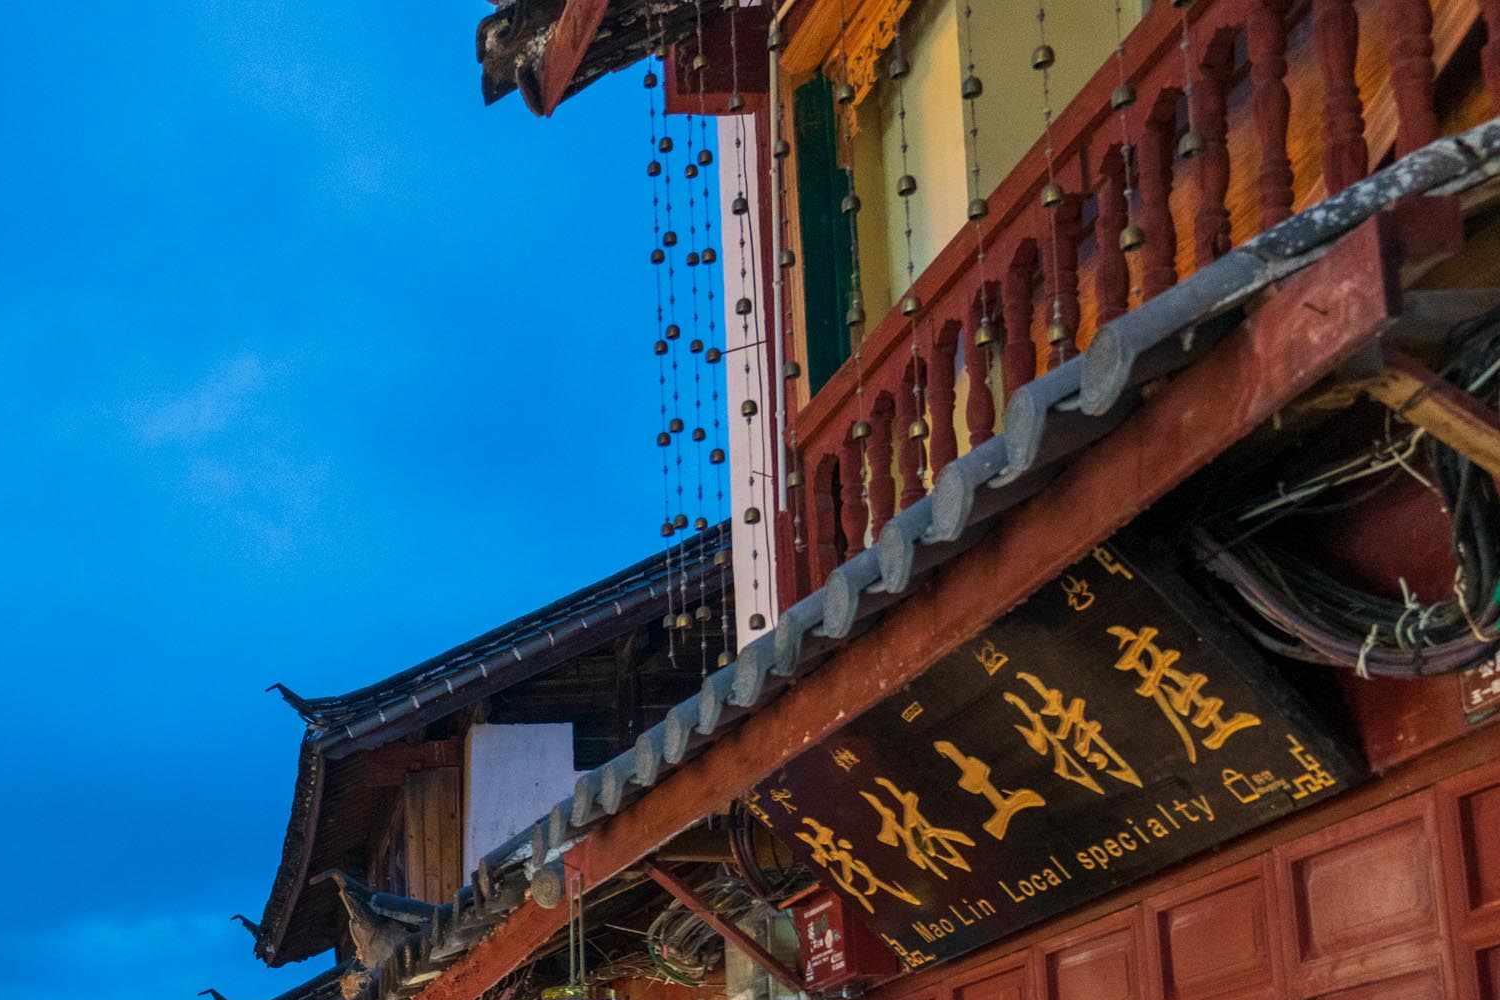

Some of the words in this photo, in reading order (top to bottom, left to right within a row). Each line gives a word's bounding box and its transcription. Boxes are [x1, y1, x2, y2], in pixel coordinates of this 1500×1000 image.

[911, 921, 955, 943] Mao
[949, 897, 997, 926] Lin
[998, 856, 1072, 903] Local
[1076, 795, 1216, 870] specialty
